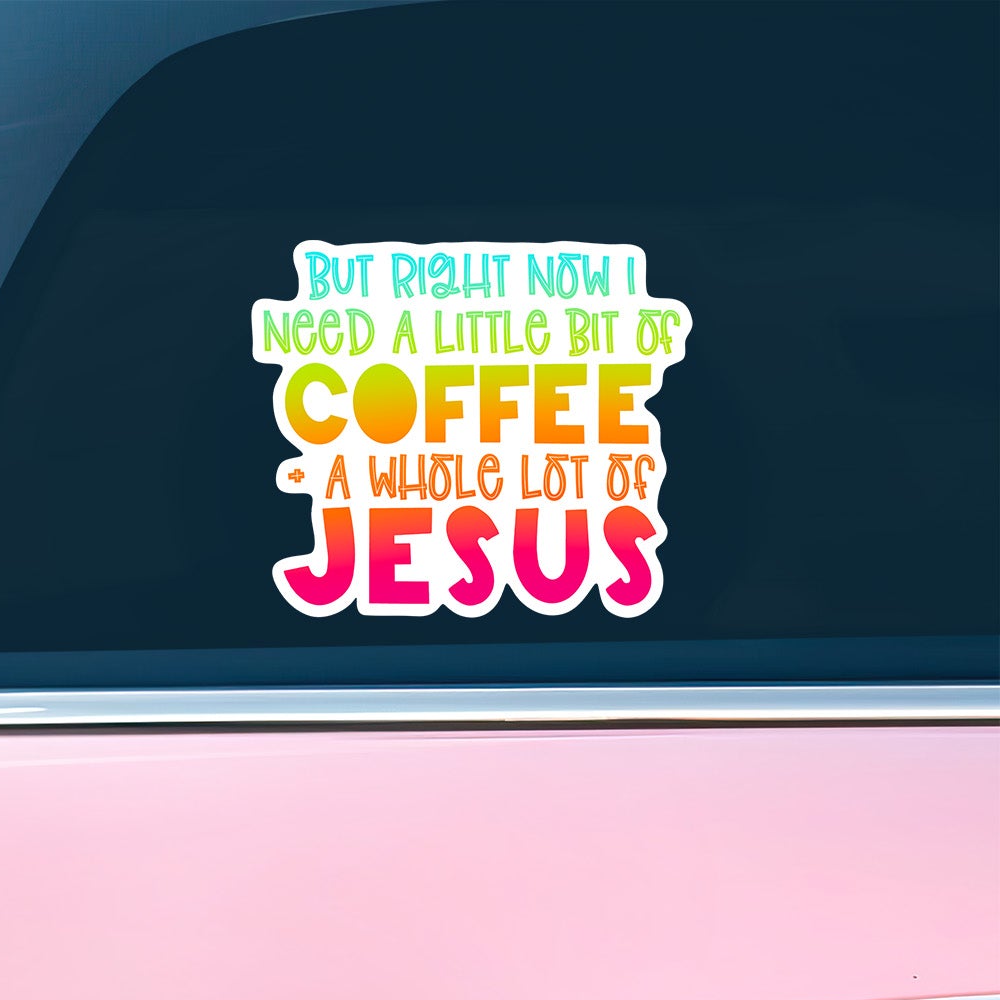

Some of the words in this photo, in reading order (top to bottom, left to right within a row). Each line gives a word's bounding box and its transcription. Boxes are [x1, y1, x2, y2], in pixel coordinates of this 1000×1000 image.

[305, 251, 374, 300] BUT
[528, 252, 610, 299] NOW
[626, 256, 636, 296] I
[392, 310, 418, 354] A
[565, 308, 619, 357] BIT
[284, 362, 652, 444] COFFEE
[325, 454, 351, 500] A
[521, 453, 589, 501] LOT
[284, 505, 657, 606] JESUS
